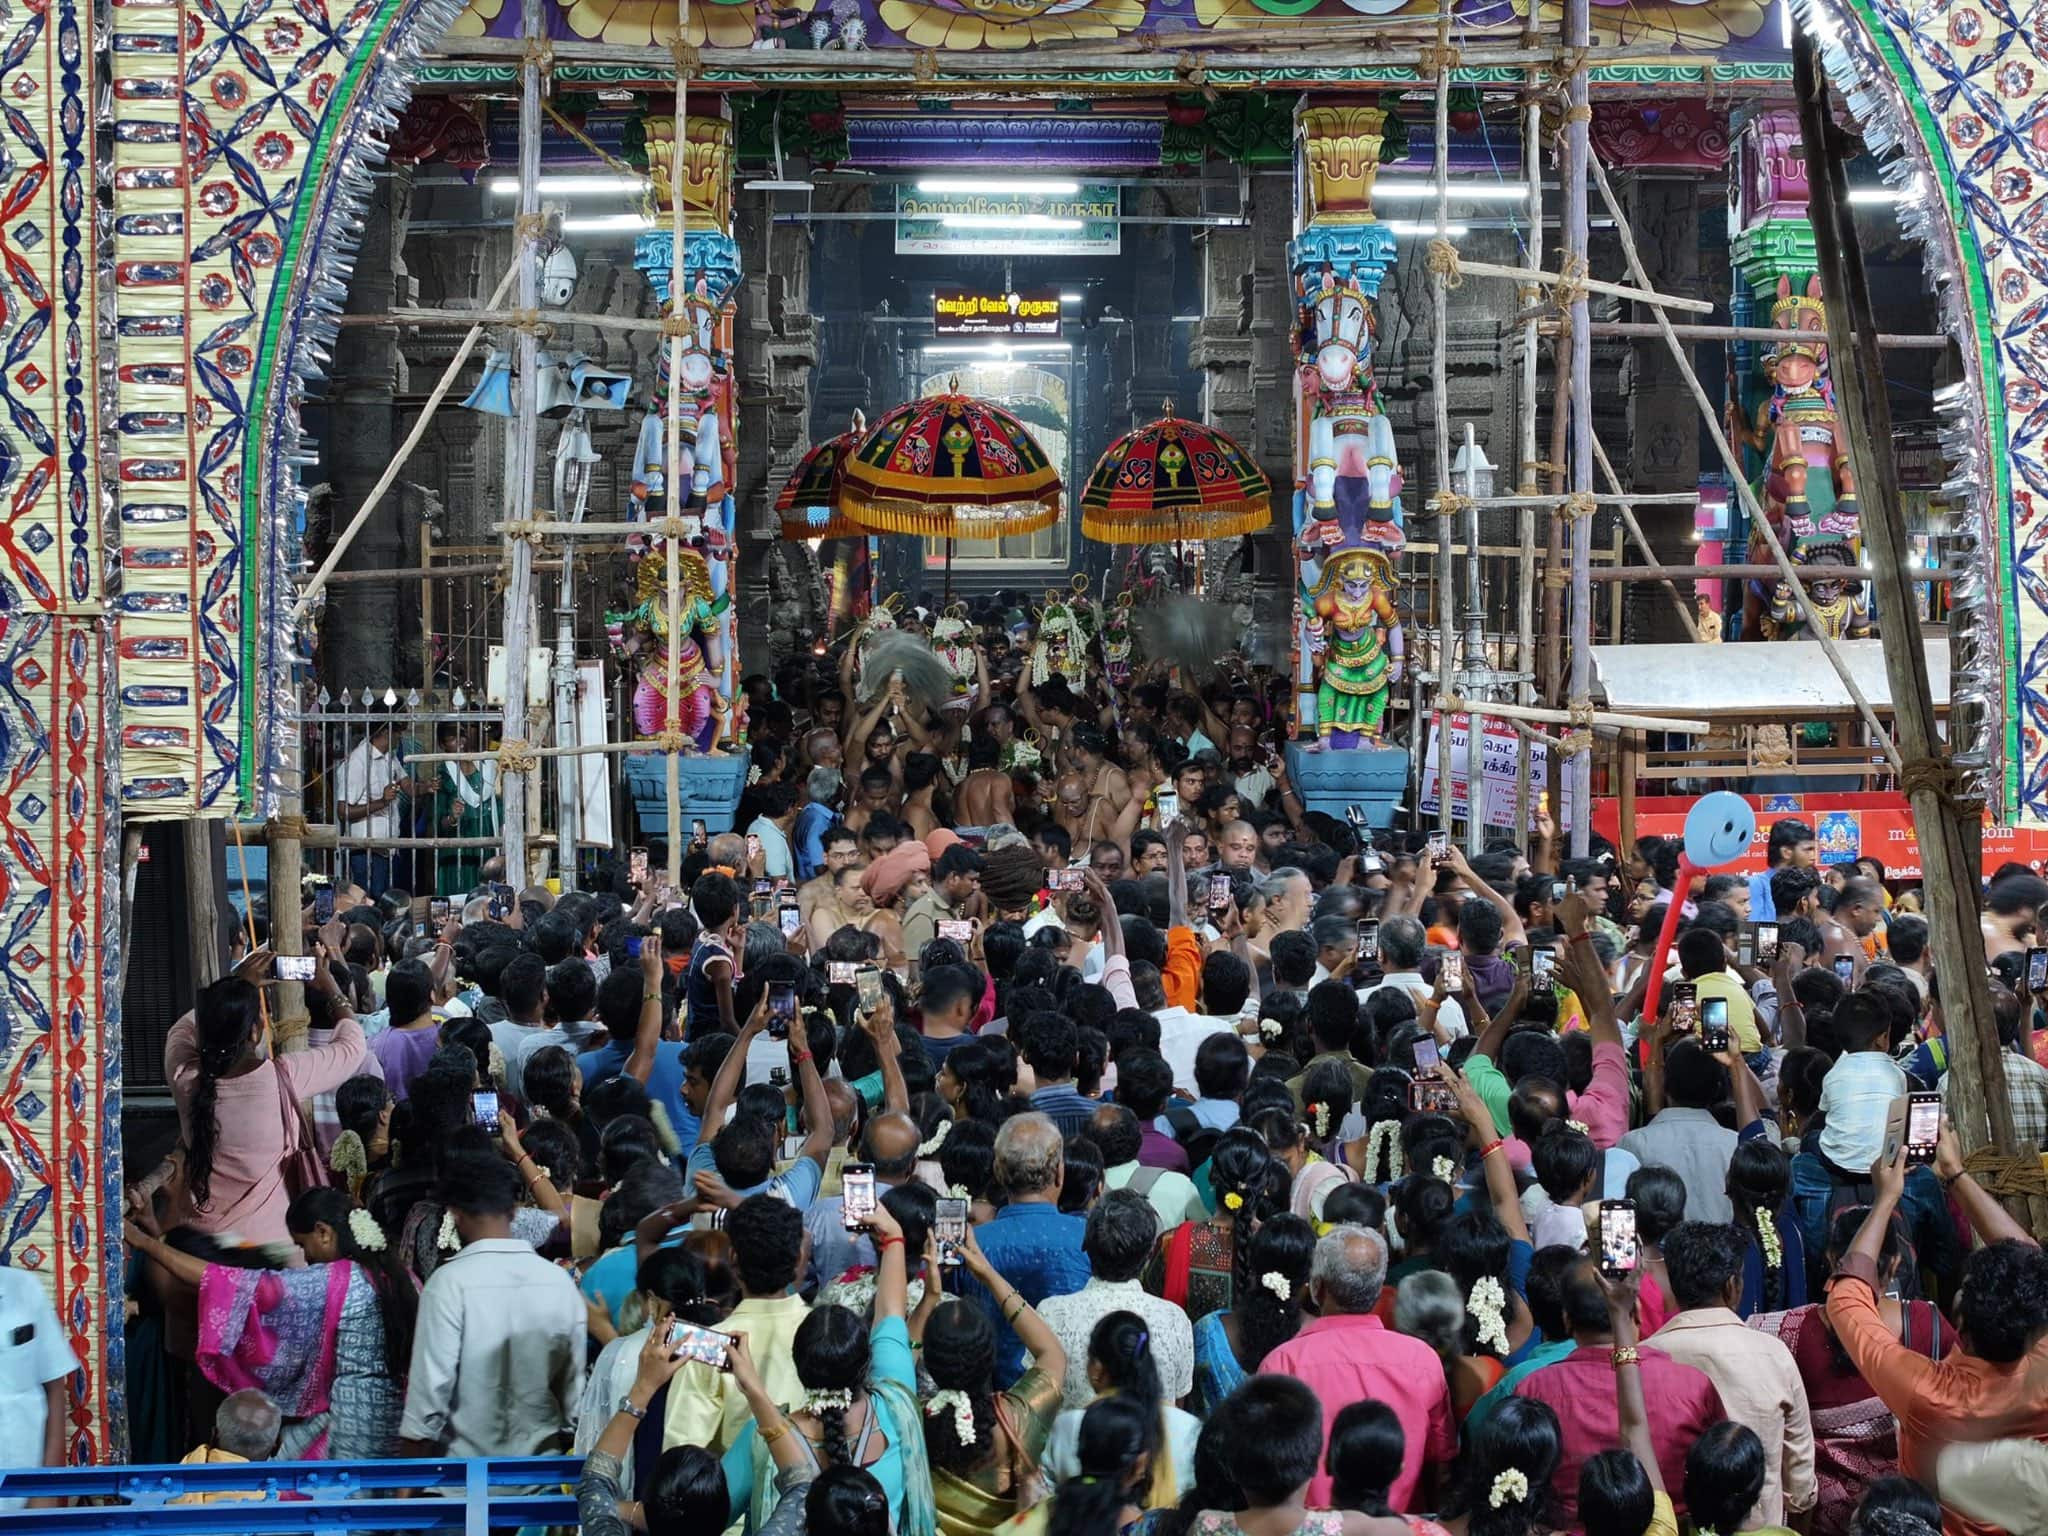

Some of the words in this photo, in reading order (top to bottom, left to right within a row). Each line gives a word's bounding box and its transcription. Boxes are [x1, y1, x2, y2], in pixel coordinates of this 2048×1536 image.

[936, 294, 978, 317] வெற்றி
[979, 294, 1009, 313] வேல்
[1018, 300, 1059, 316] முருகா
